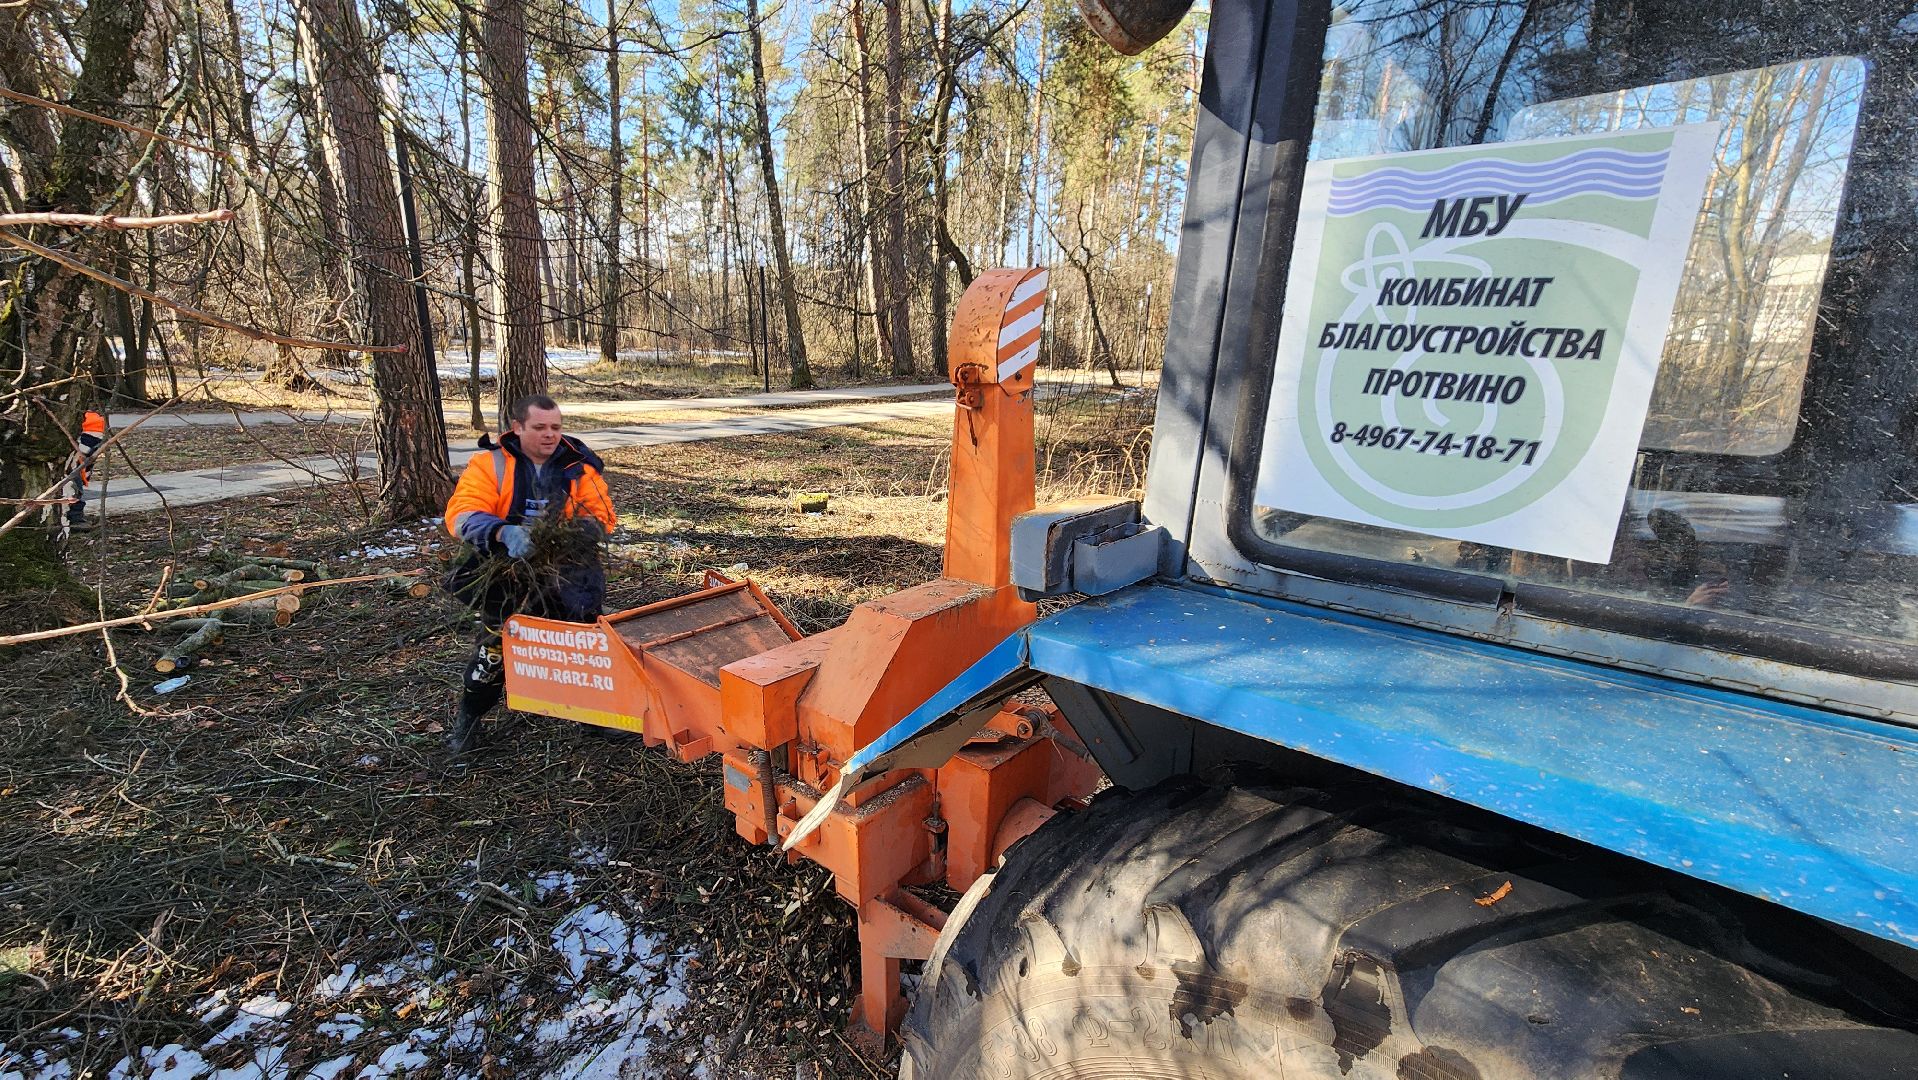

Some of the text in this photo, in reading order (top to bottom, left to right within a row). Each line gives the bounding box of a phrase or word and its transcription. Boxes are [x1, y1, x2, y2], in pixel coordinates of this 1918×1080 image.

[1419, 192, 1531, 240] МБУ
[1377, 277, 1553, 307] КОМБИНАТ
[1318, 321, 1606, 360] БЛАГОУСТРОЙСТВА
[1362, 368, 1527, 405] ПРОТВИНО
[1330, 422, 1542, 466] 8-4967-74-18-71
